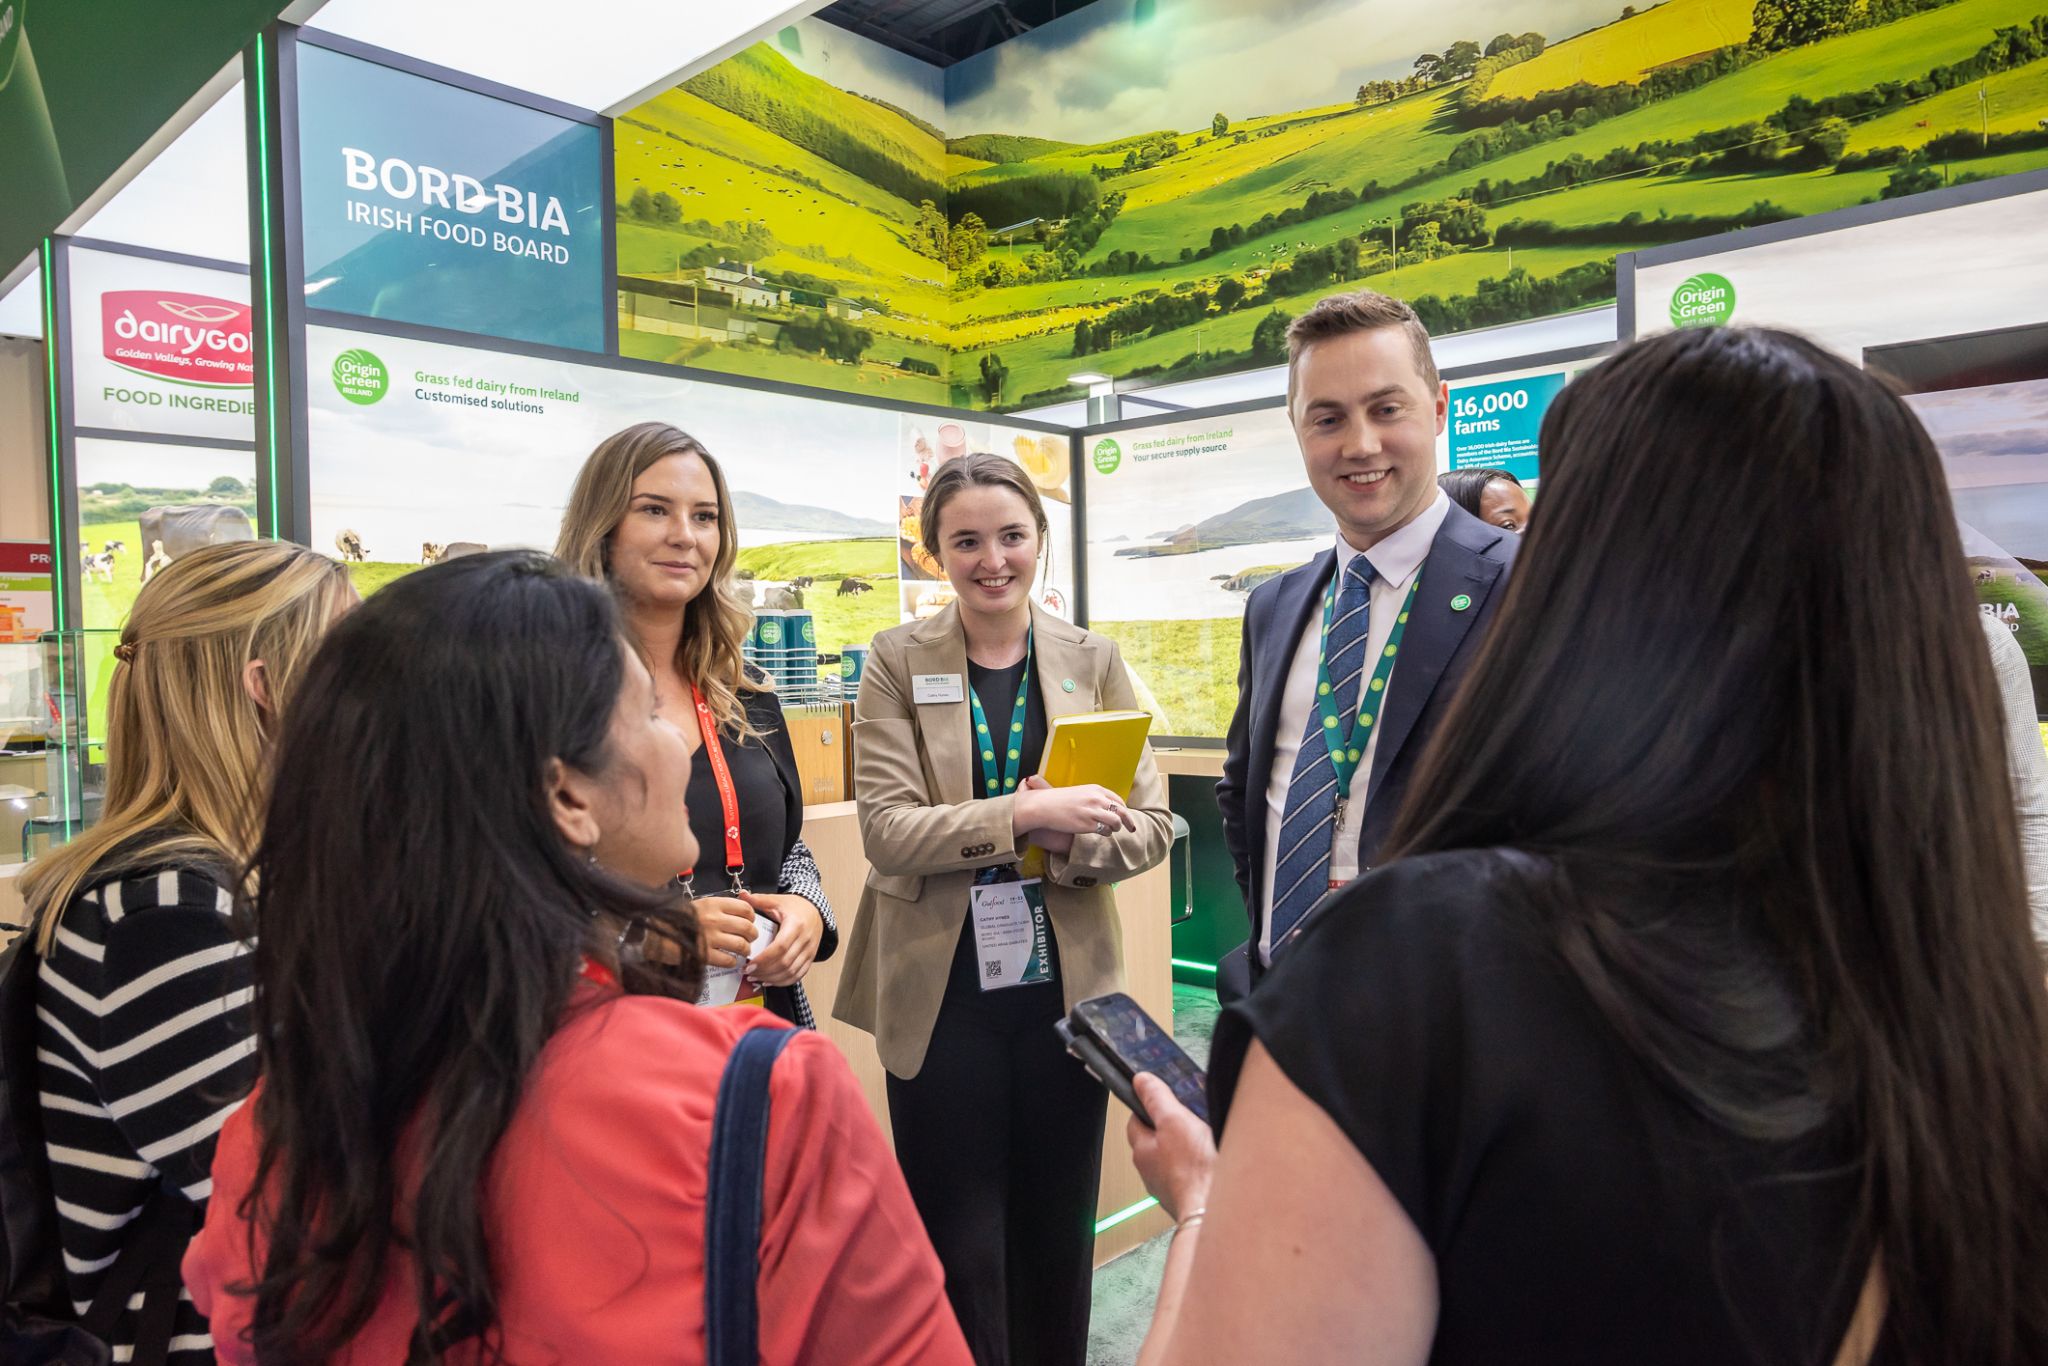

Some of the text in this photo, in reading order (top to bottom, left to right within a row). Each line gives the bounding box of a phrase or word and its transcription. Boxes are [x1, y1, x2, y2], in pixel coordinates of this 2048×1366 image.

[342, 148, 570, 236] BORD BIA
[348, 200, 569, 264] IRISH FOOD BOARD
[1680, 286, 1725, 304] Origin
[1680, 302, 1725, 317] Green
[116, 348, 152, 360] Golden
[154, 352, 192, 366] Valleys,
[195, 358, 234, 372] Growing
[342, 361, 380, 378] Origin
[342, 374, 380, 388] Green
[415, 372, 579, 402] Grass fed dairy from Ireland
[104, 388, 162, 406] FOOD
[342, 388, 372, 396] IRELAND
[416, 388, 544, 414] Customised solutions
[1454, 390, 1528, 418] 16,000
[1454, 419, 1500, 436] farms
[1132, 428, 1232, 450] Grass fed dairy from Ireland
[1134, 444, 1226, 462] Your secure supply source
[30, 553, 51, 563] PR
[1034, 905, 1048, 974] EXHIBITOR
